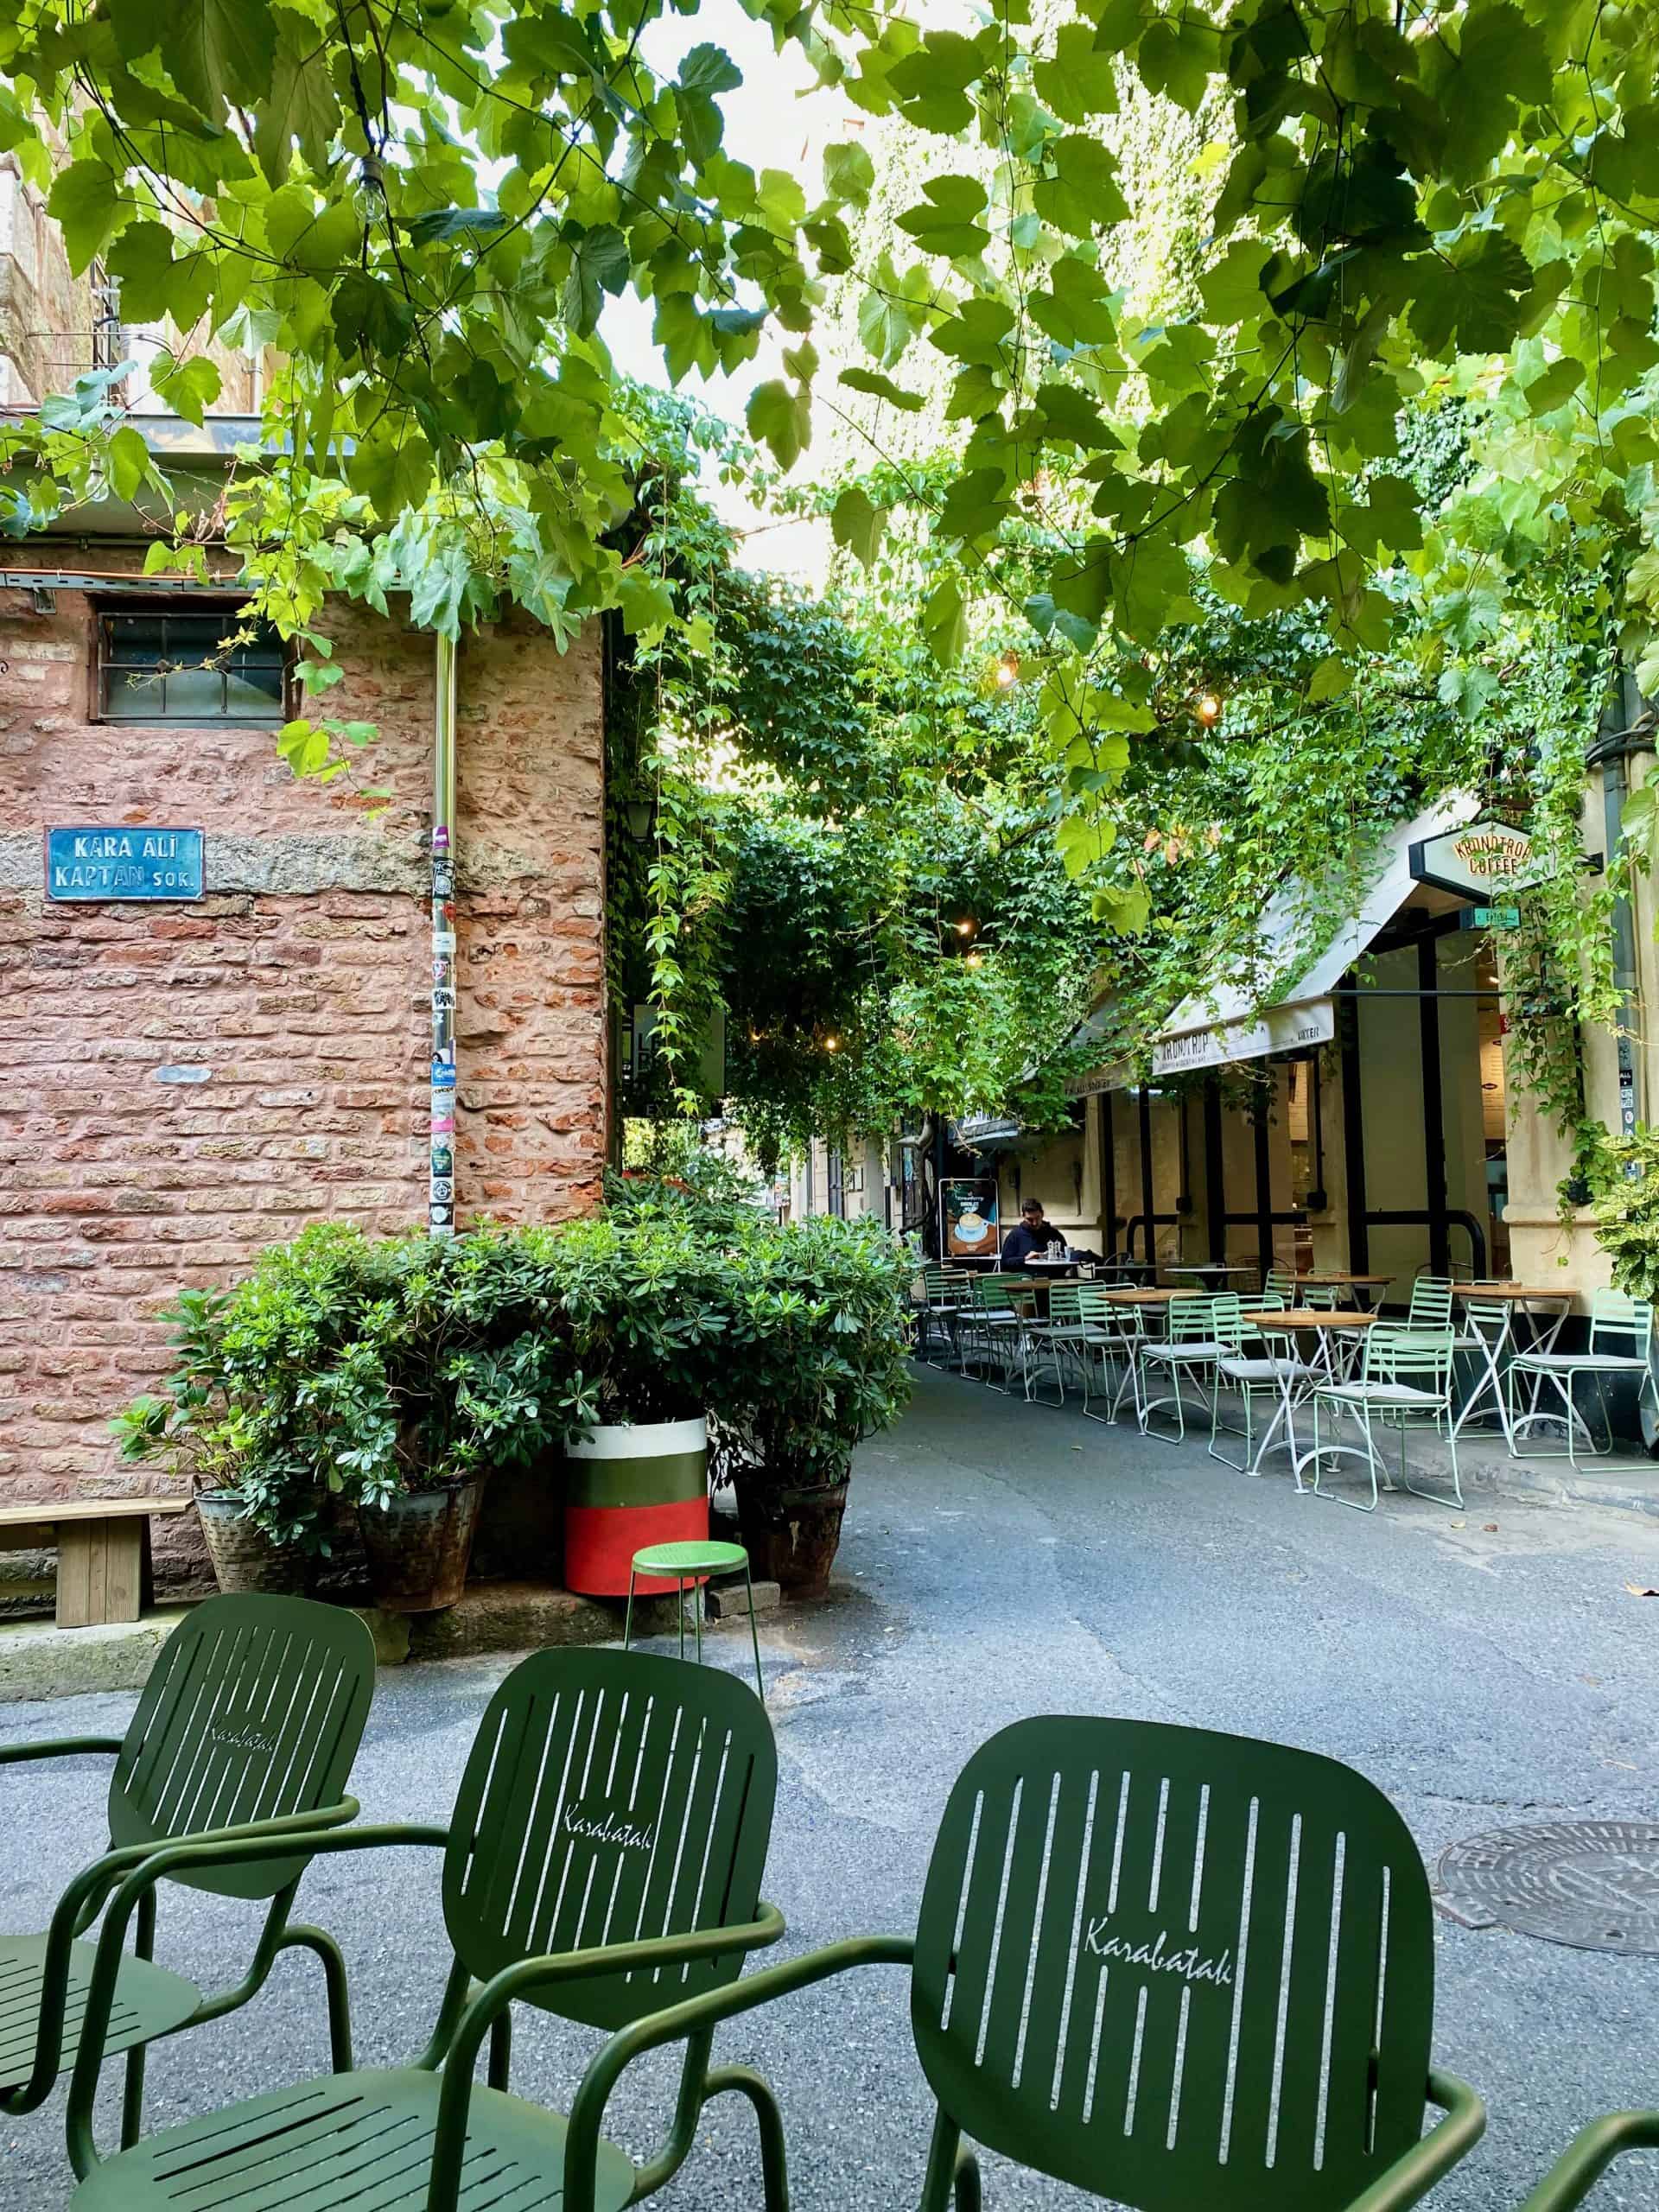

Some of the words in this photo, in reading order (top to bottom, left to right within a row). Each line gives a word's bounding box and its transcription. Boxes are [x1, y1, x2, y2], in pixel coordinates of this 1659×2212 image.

[74, 836, 131, 858] KARA
[143, 836, 179, 858] ALİ
[55, 866, 144, 887] KAPTAN
[564, 1802, 652, 1849] Karabatak
[1084, 1916, 1232, 1986] Karabatak
